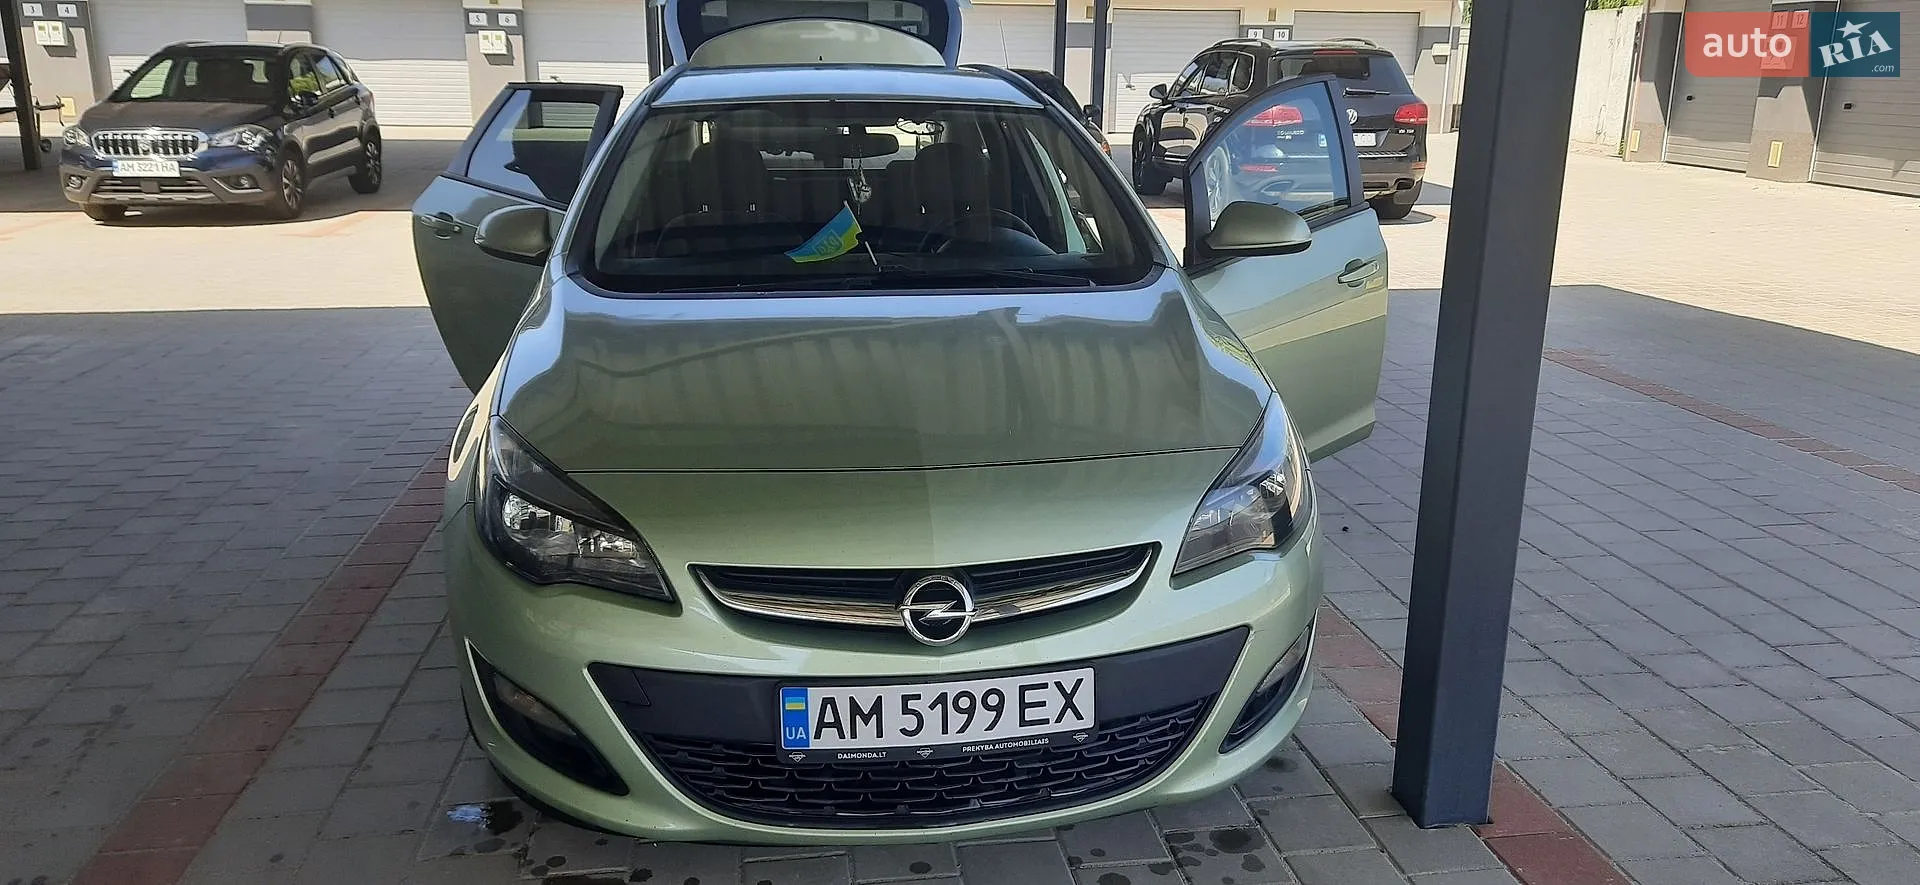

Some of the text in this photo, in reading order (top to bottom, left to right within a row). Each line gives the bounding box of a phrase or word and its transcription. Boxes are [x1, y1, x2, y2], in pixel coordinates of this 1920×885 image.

[120, 161, 135, 172] AM
[161, 162, 176, 172] HA
[813, 677, 1085, 740] AM 5199 EX
[786, 726, 807, 740] UA
[962, 738, 1049, 753] PREKYBA AUTOMOBILIAIS
[837, 751, 887, 760] DAIMONDA.LT
